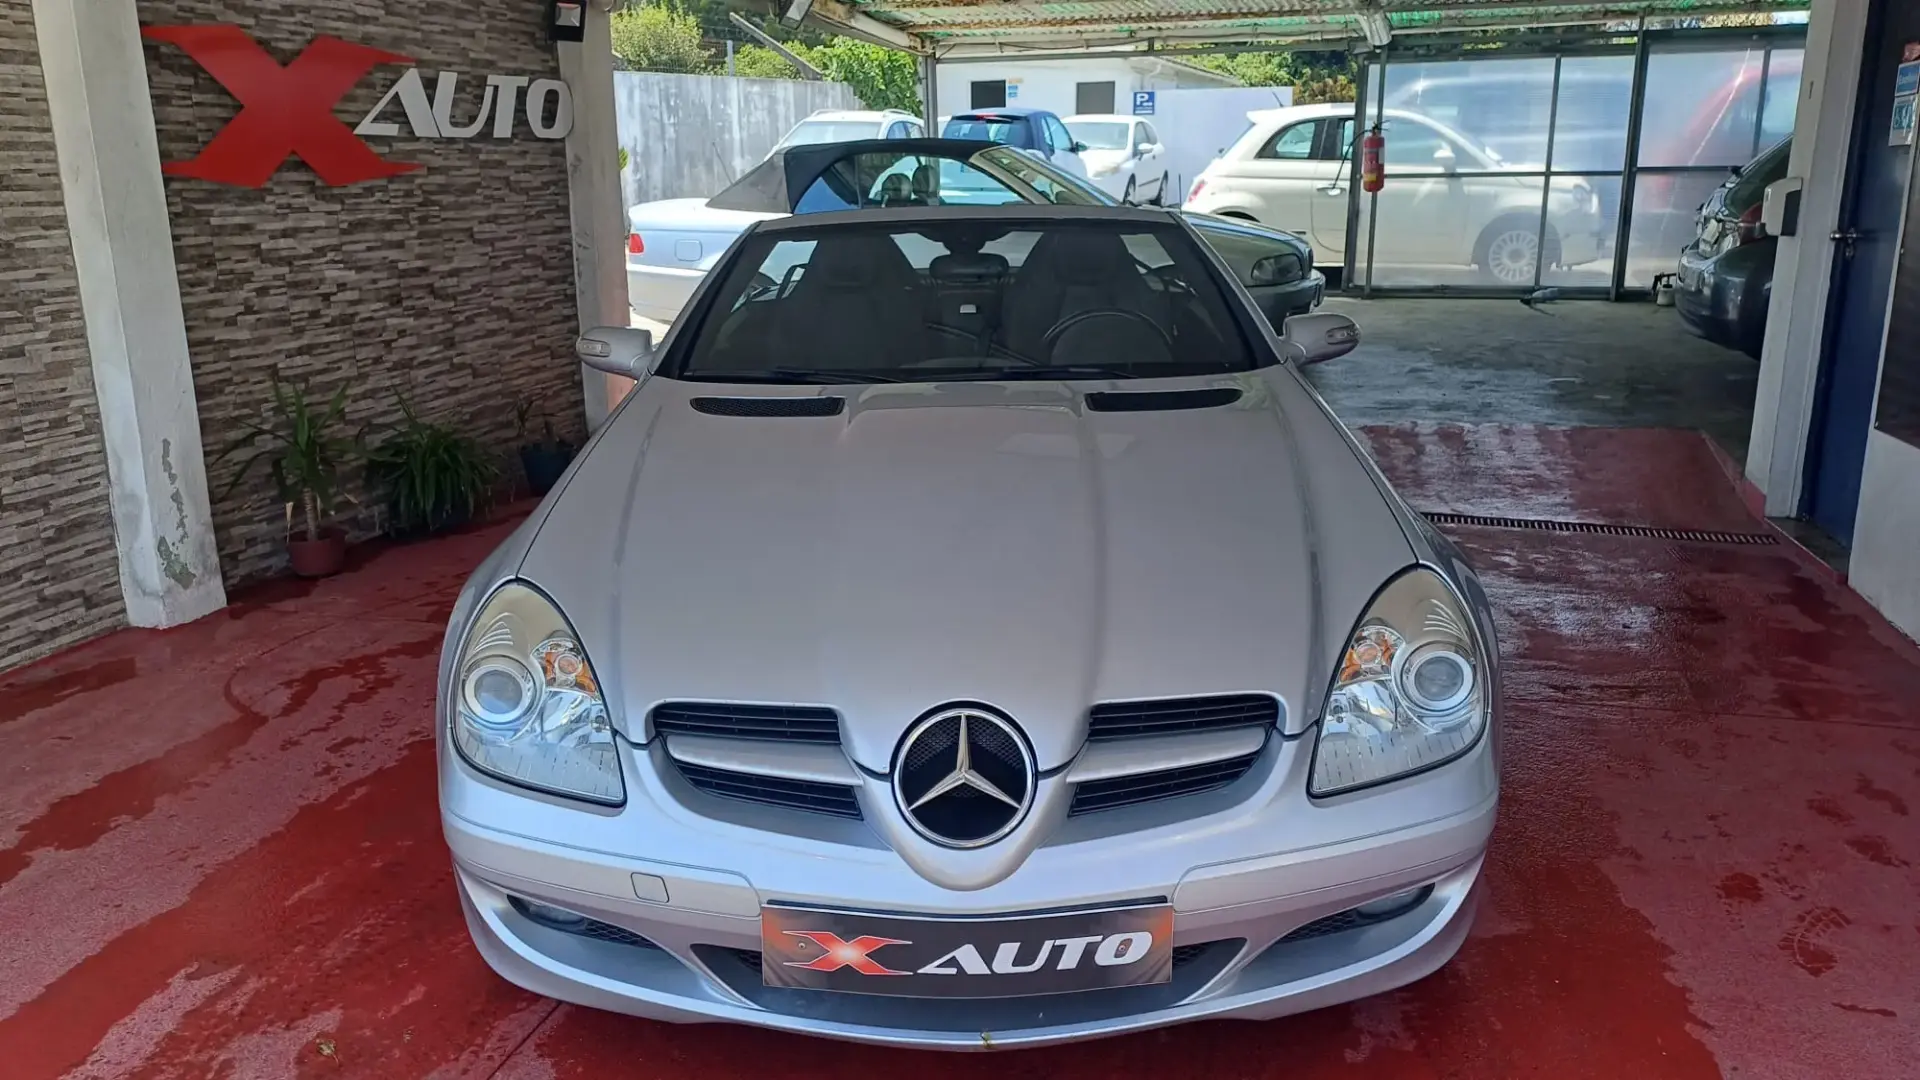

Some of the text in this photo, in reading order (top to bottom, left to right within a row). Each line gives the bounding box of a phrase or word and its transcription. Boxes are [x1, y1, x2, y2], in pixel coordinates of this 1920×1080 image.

[141, 25, 574, 188] X AUTO
[1136, 93, 1149, 106] P
[783, 930, 1153, 975] X AUTO
